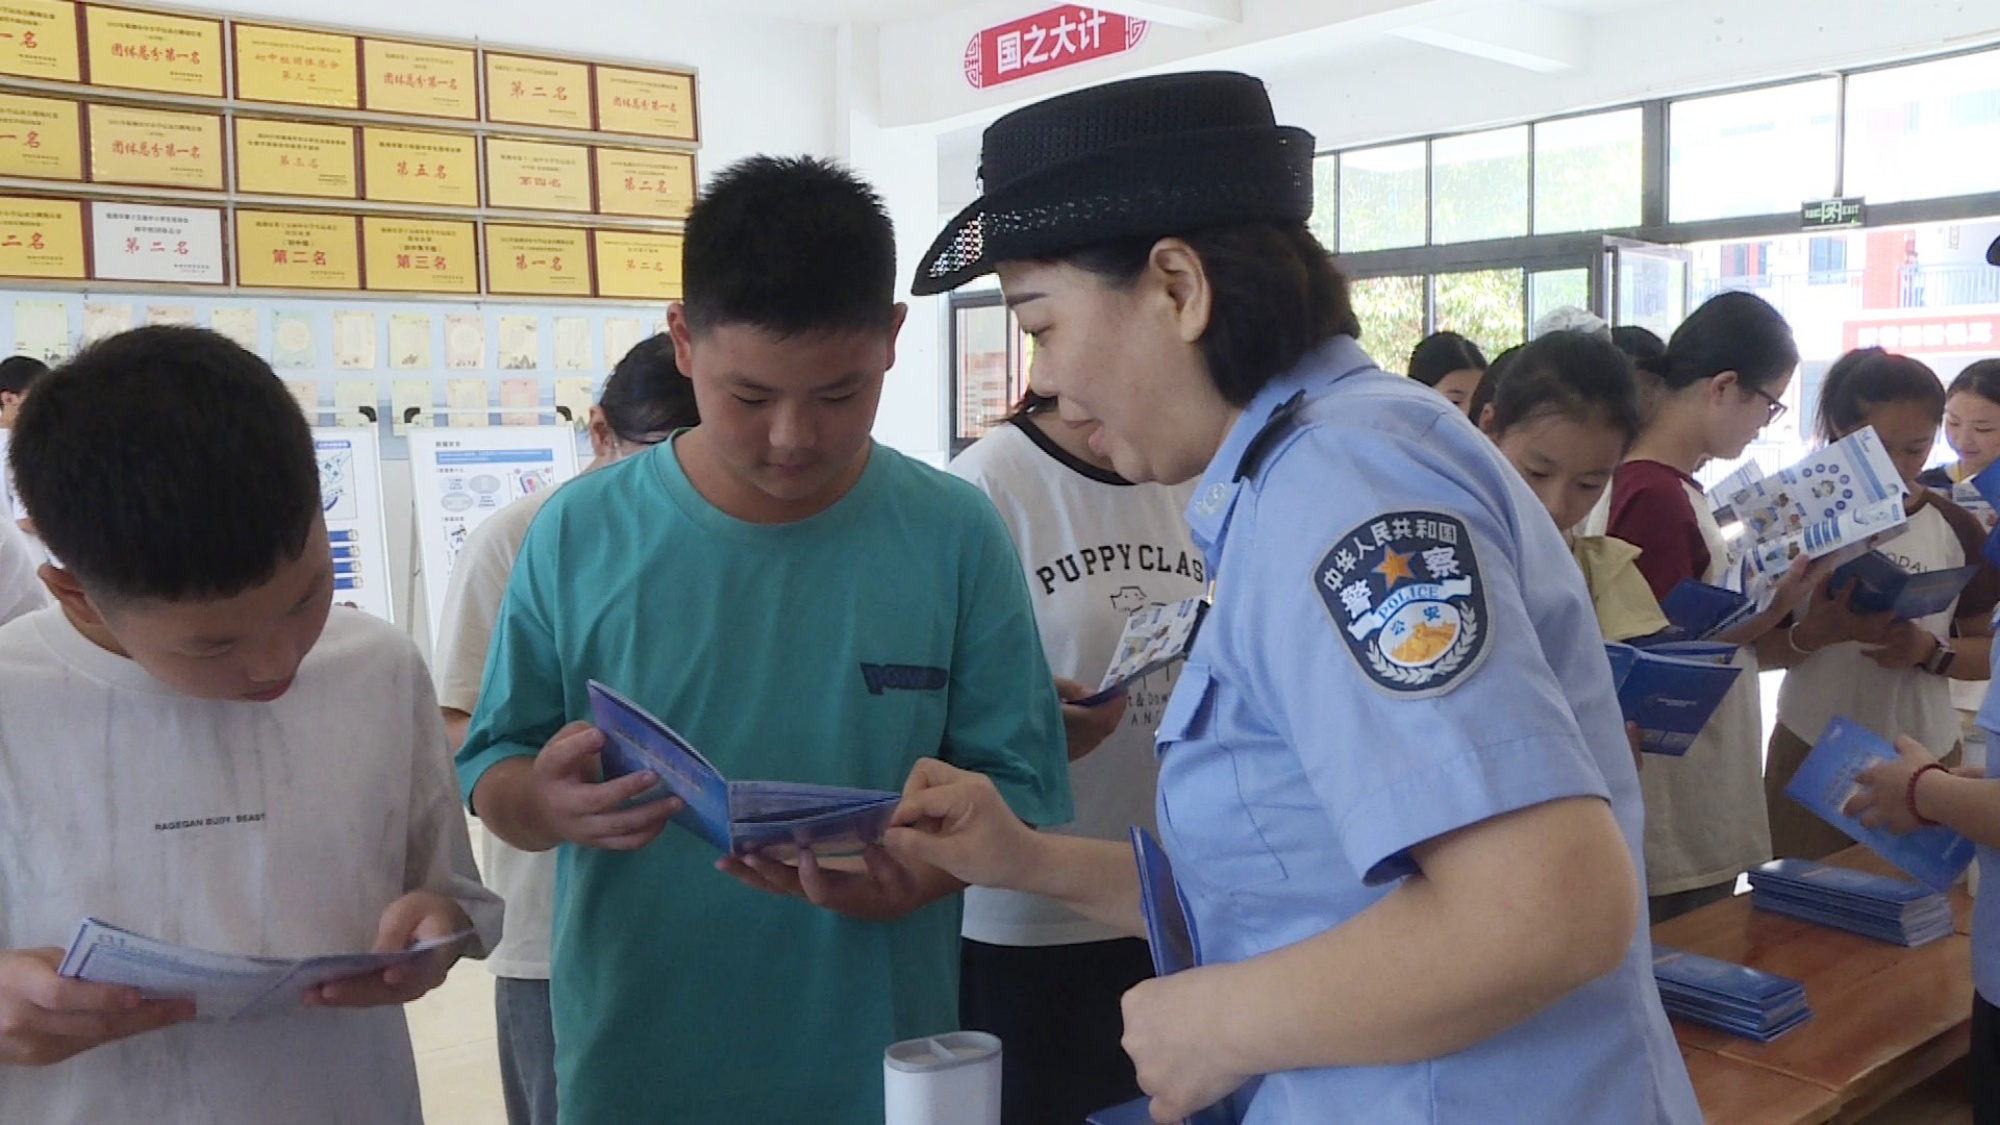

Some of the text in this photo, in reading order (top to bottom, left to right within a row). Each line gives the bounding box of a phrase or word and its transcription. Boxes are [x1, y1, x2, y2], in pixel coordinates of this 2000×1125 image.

[997, 8, 1106, 74] 国之大计
[112, 43, 200, 65] 团体总分第一名
[384, 72, 458, 90] 团体总分第一名
[510, 81, 568, 101] 第二名
[613, 96, 677, 113] 团体总分第一名
[112, 140, 200, 159] 团体总分第一名
[397, 161, 447, 179] 第五名
[625, 176, 667, 194] 第二名
[1842, 205, 1860, 215] EXIT
[125, 237, 189, 254] 第二名
[273, 249, 326, 266] 第二名
[397, 253, 446, 270] 第三名
[516, 254, 562, 272] 第一名
[1324, 518, 1458, 591] 中华人民共和国
[1036, 544, 1130, 595] PUPPY
[1378, 584, 1439, 621] POLICE
[1391, 605, 1441, 635] 公安
